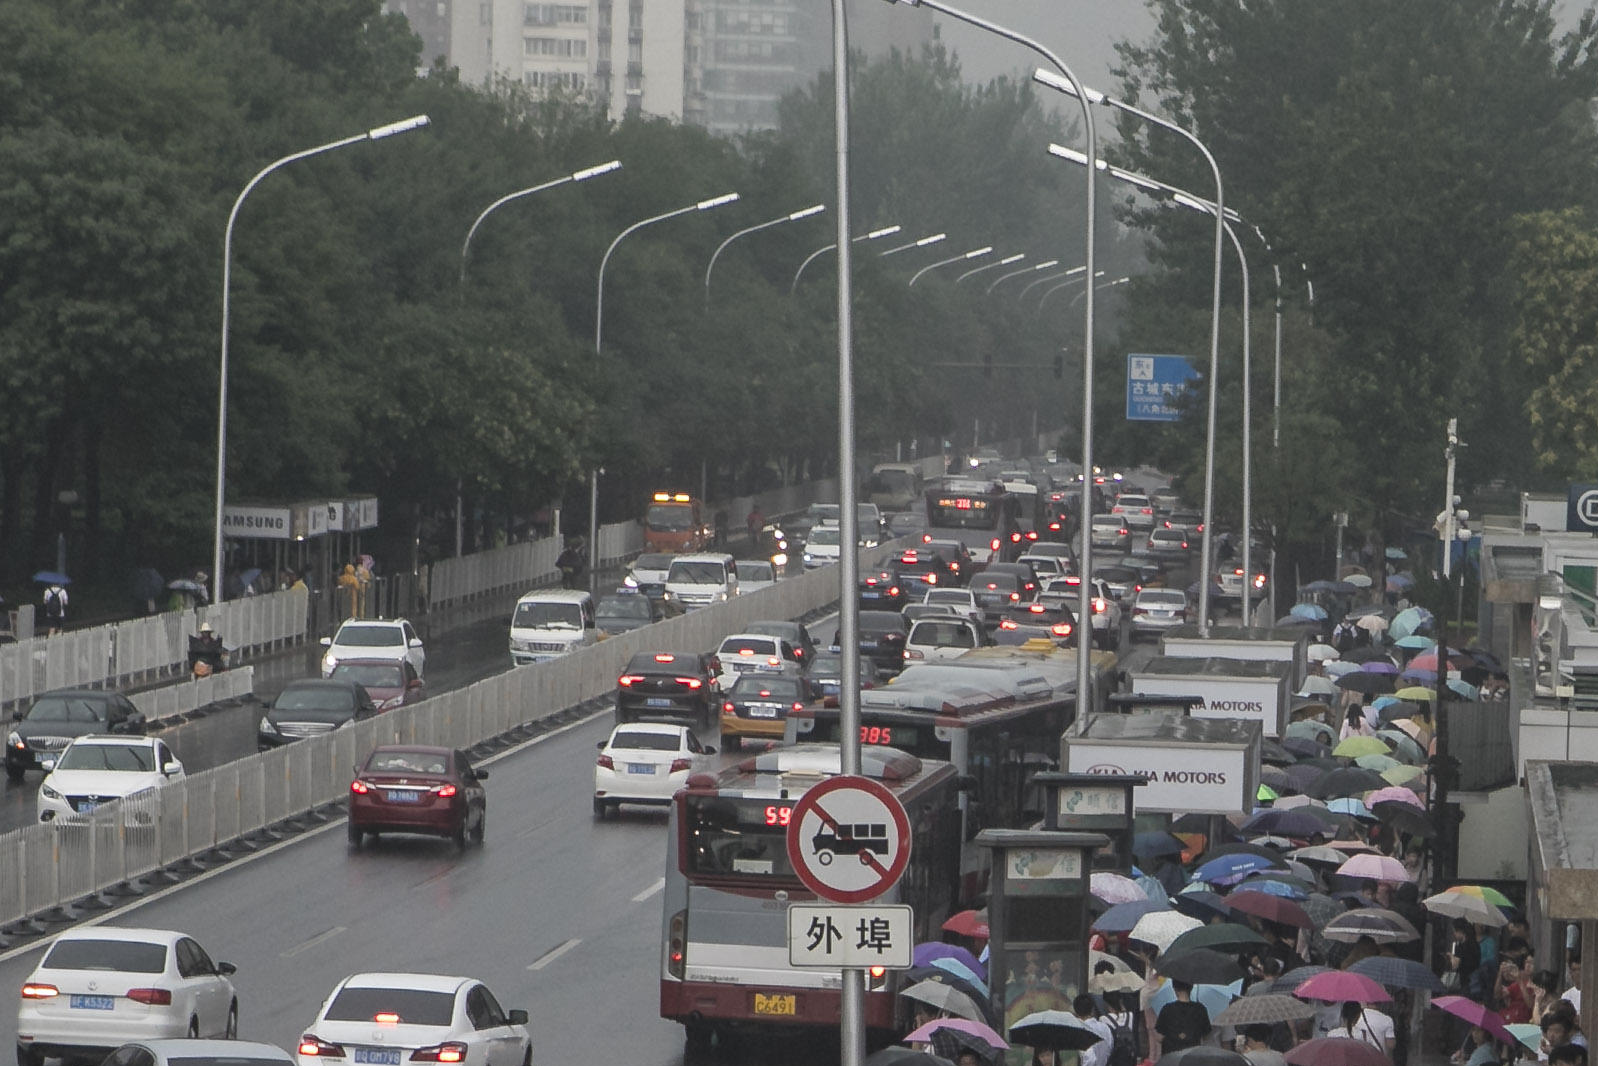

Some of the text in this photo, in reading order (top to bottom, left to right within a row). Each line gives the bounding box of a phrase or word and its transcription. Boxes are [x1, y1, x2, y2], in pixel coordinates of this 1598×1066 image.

[222, 514, 284, 529] AMSUNG
[1210, 700, 1263, 713] MOTORS
[859, 726, 892, 745] 385
[1163, 770, 1226, 785] MOTORS
[806, 915, 893, 955] 外埠
